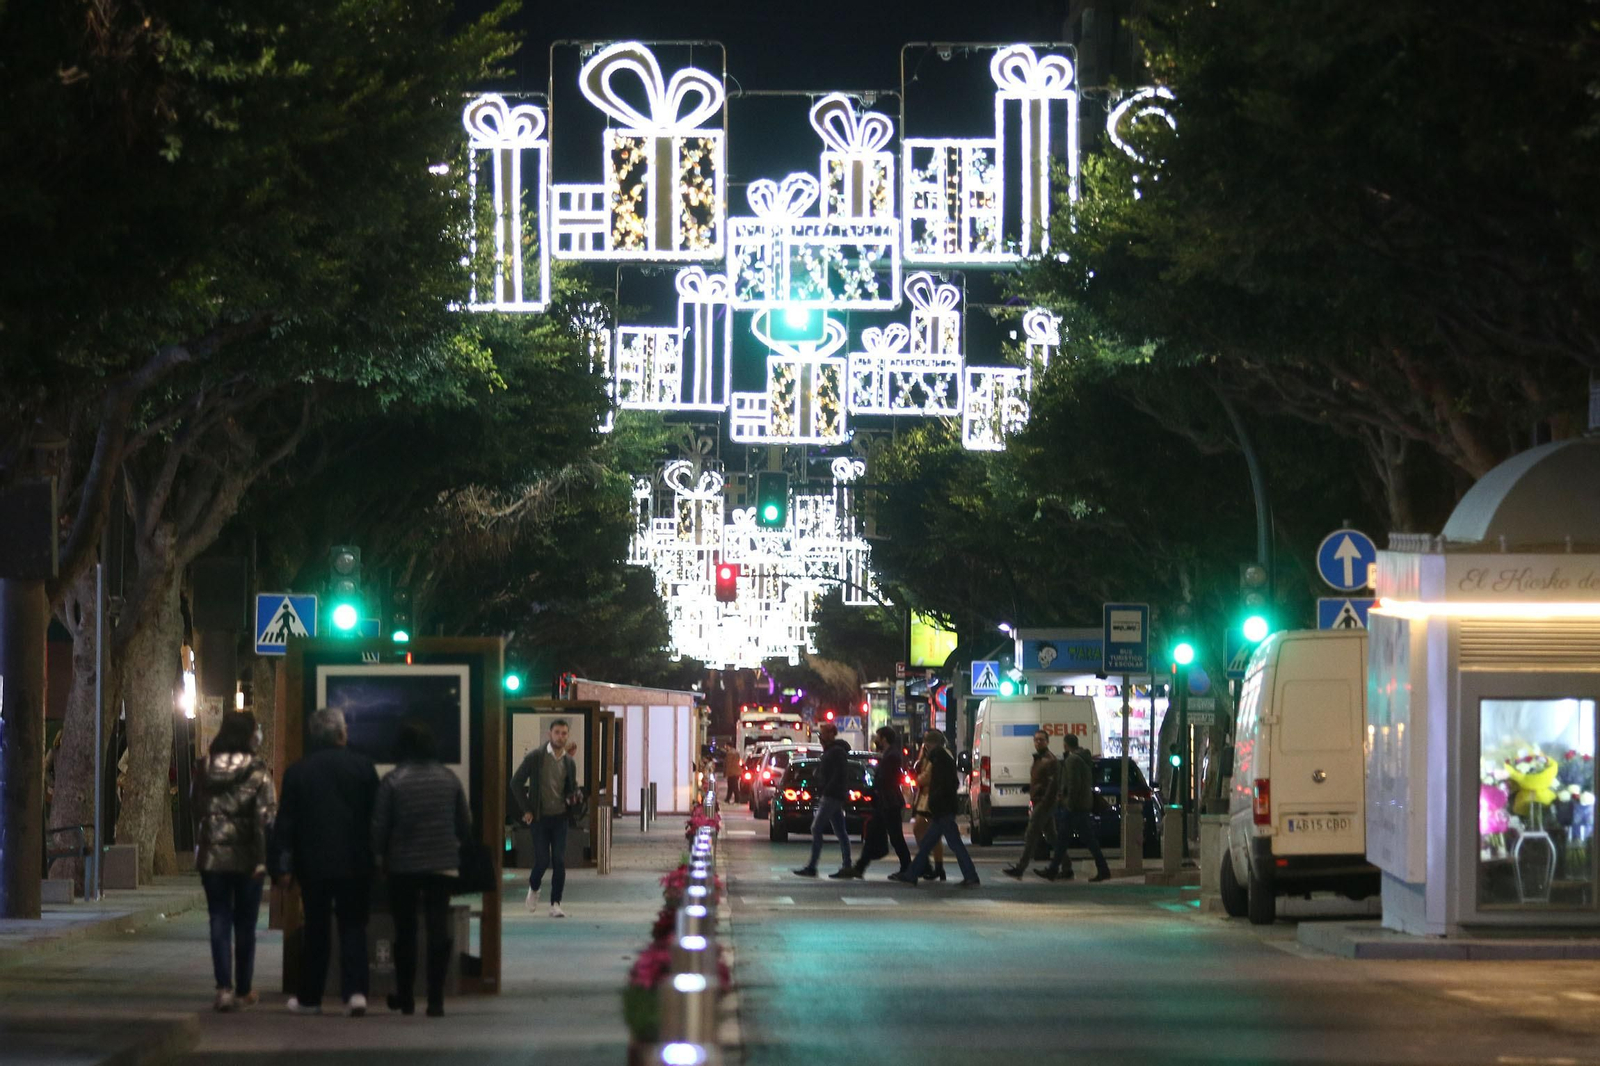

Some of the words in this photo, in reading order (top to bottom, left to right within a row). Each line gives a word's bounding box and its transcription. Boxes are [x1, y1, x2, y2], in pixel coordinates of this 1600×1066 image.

[1458, 567, 1489, 592] El
[1492, 566, 1570, 592] Kiosko
[1043, 723, 1088, 736] SEUR
